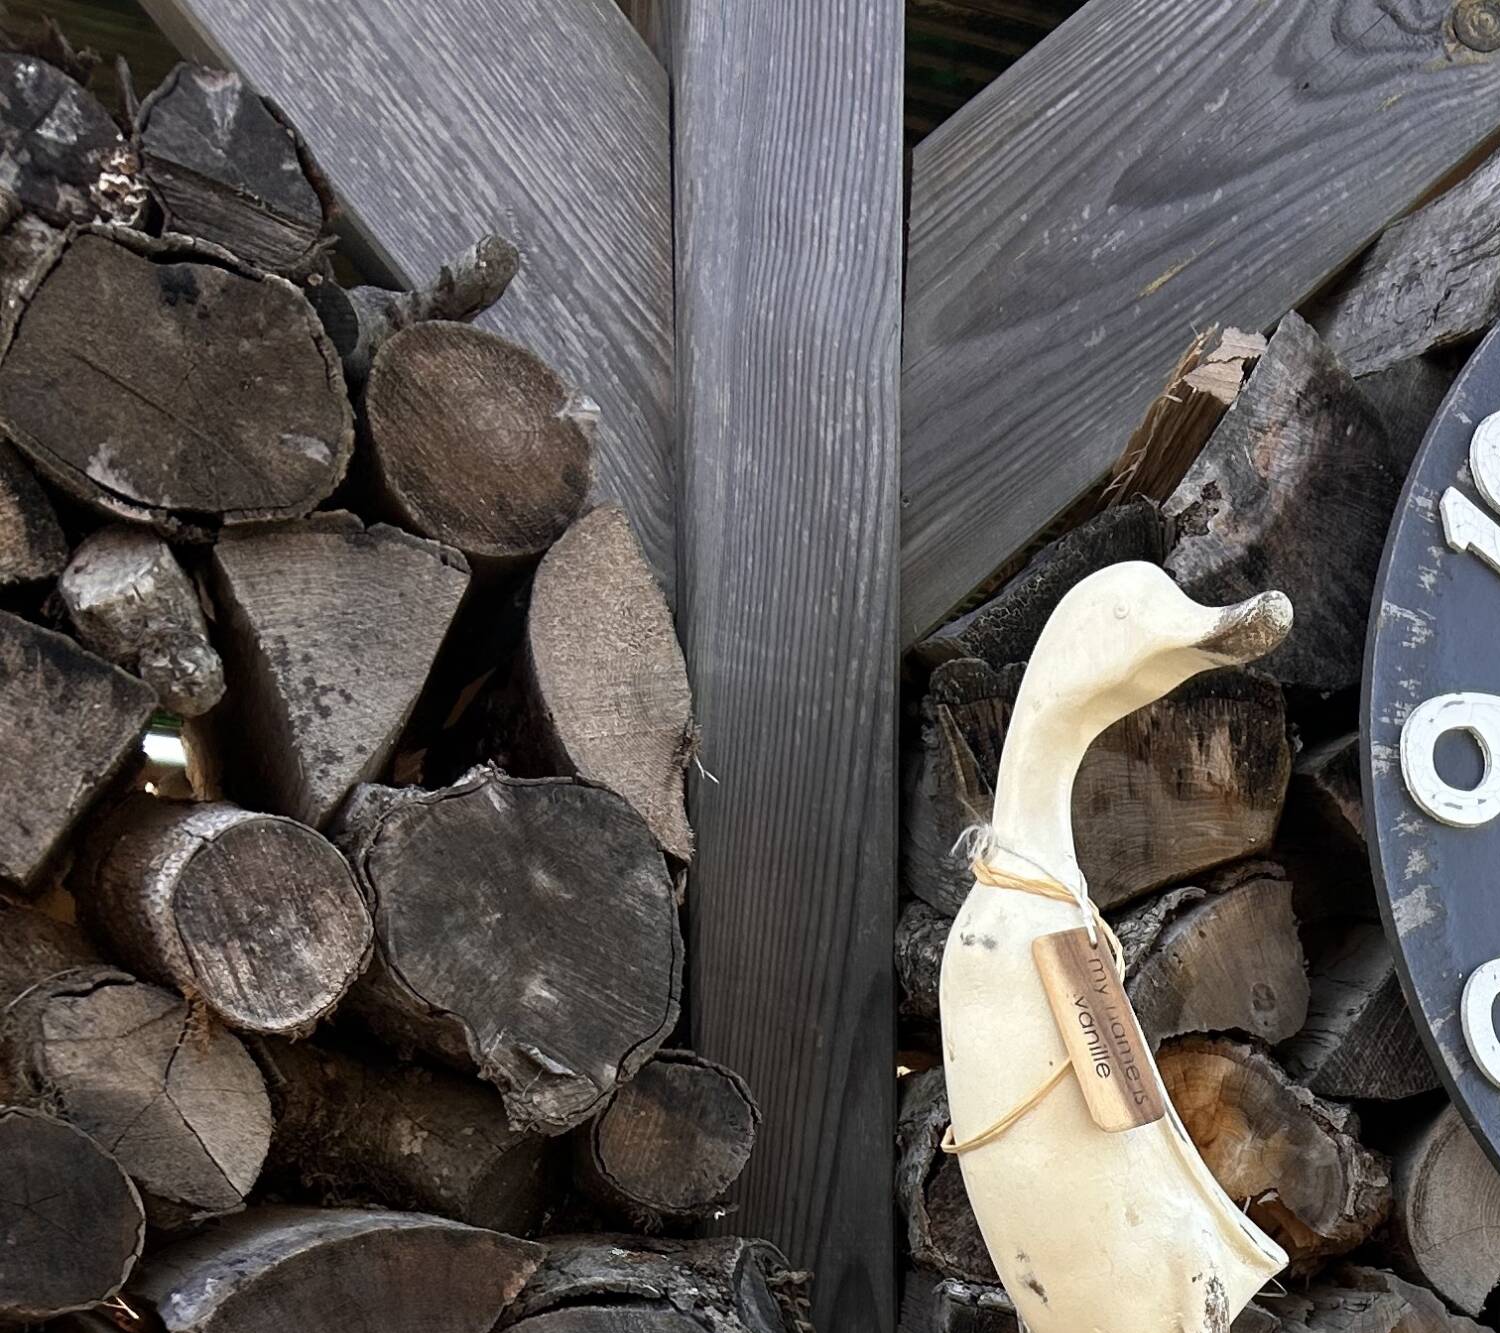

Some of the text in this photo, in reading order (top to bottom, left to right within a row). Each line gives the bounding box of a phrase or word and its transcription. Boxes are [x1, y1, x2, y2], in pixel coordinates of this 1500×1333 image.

[1073, 995, 1111, 1080] vanille
[1087, 957, 1108, 995] my
[1134, 1089, 1149, 1106] is
